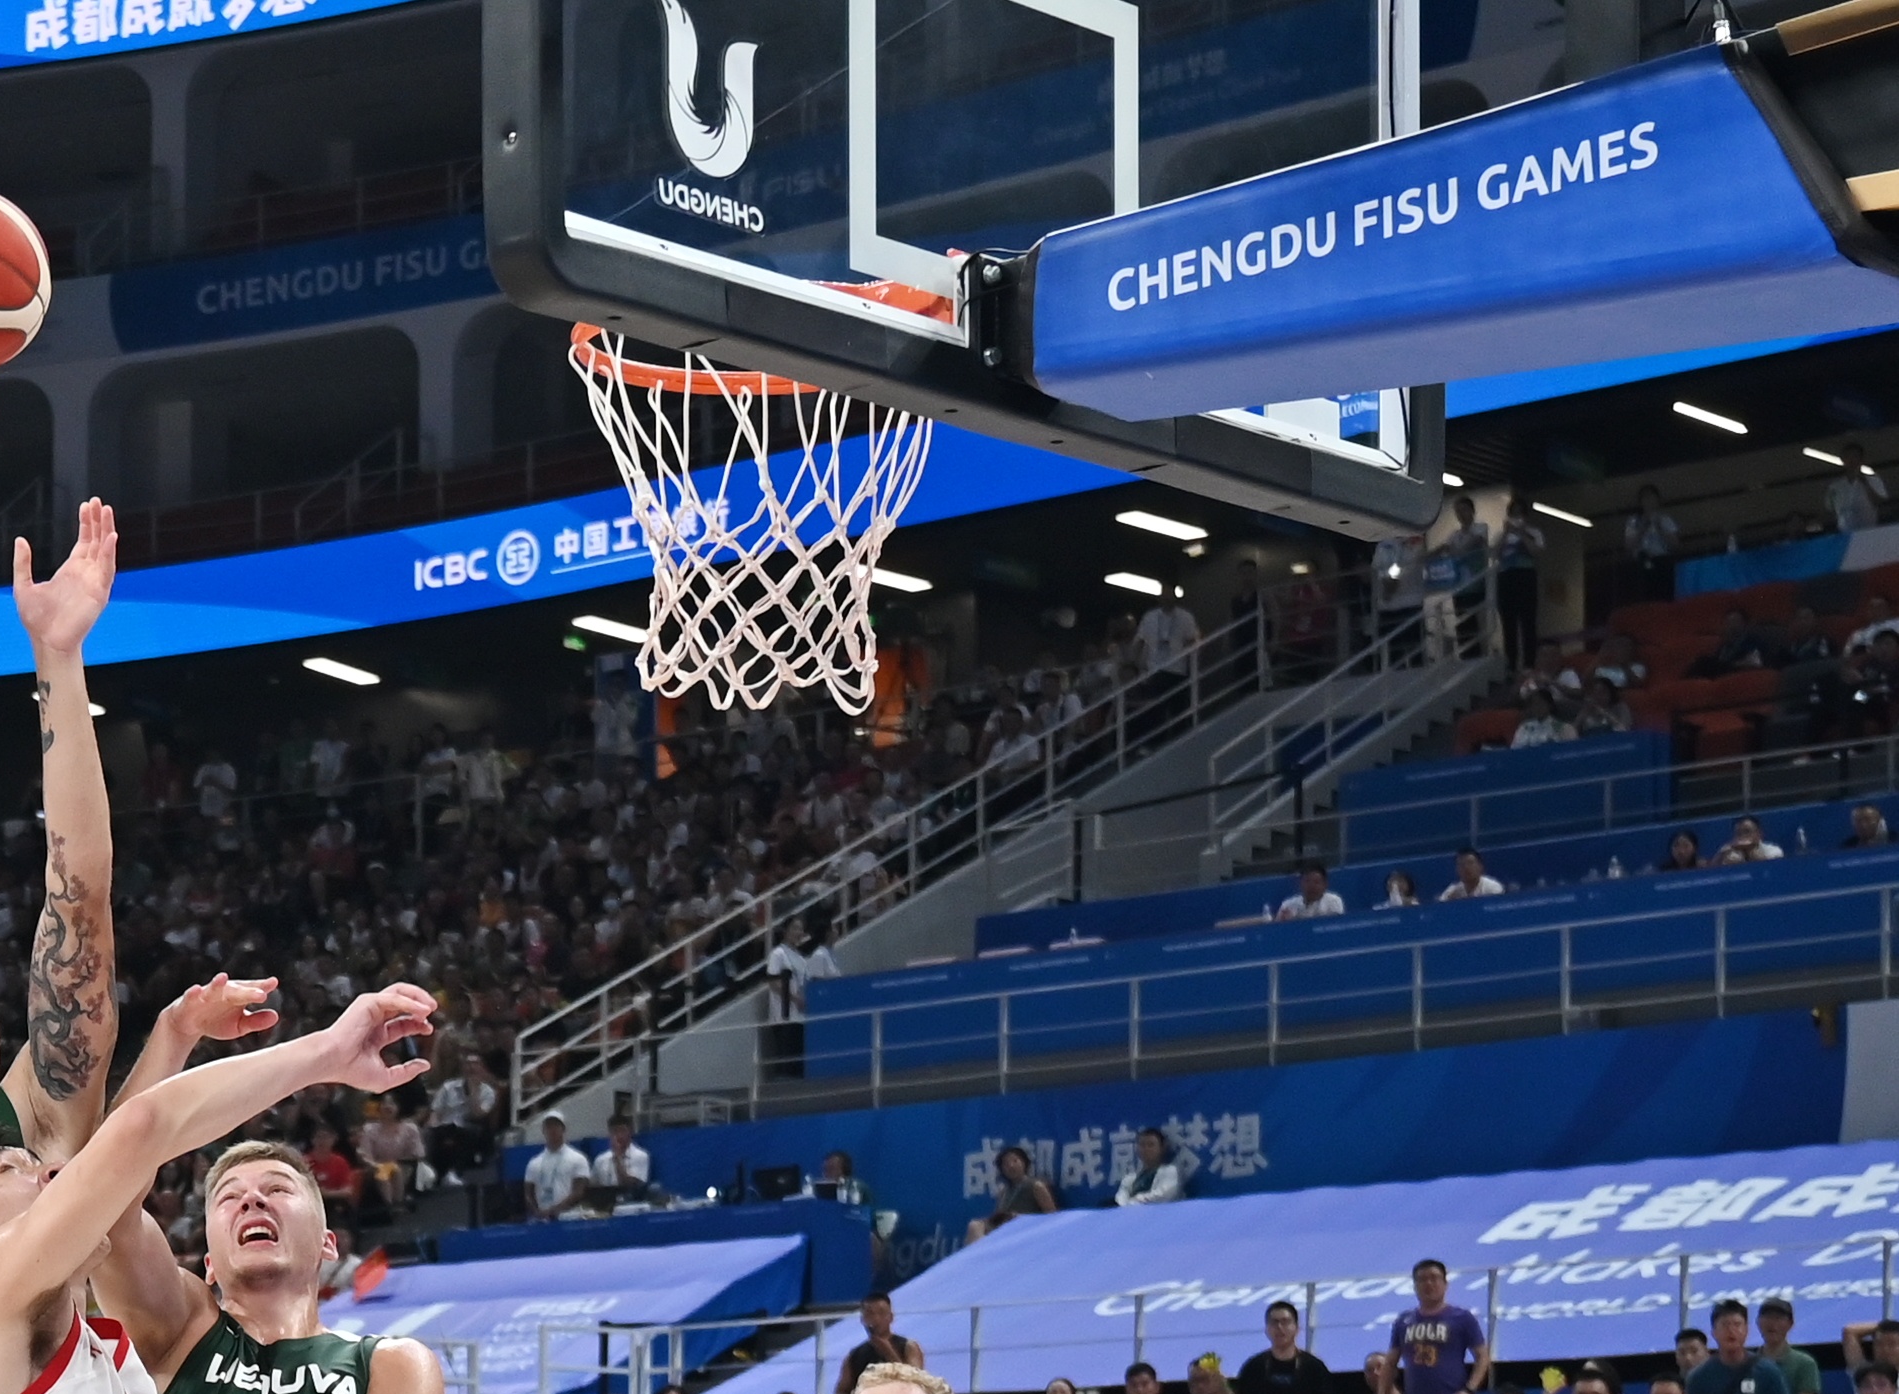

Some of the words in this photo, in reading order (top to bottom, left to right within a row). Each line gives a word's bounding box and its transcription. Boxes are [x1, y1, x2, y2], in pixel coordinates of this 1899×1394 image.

[1108, 211, 1336, 312] CHENGDU
[1354, 175, 1458, 247] FISU
[1478, 121, 1659, 210] GAMES
[195, 261, 364, 315] CHENGDU
[374, 245, 447, 287] FISU
[414, 549, 488, 591] ICBC
